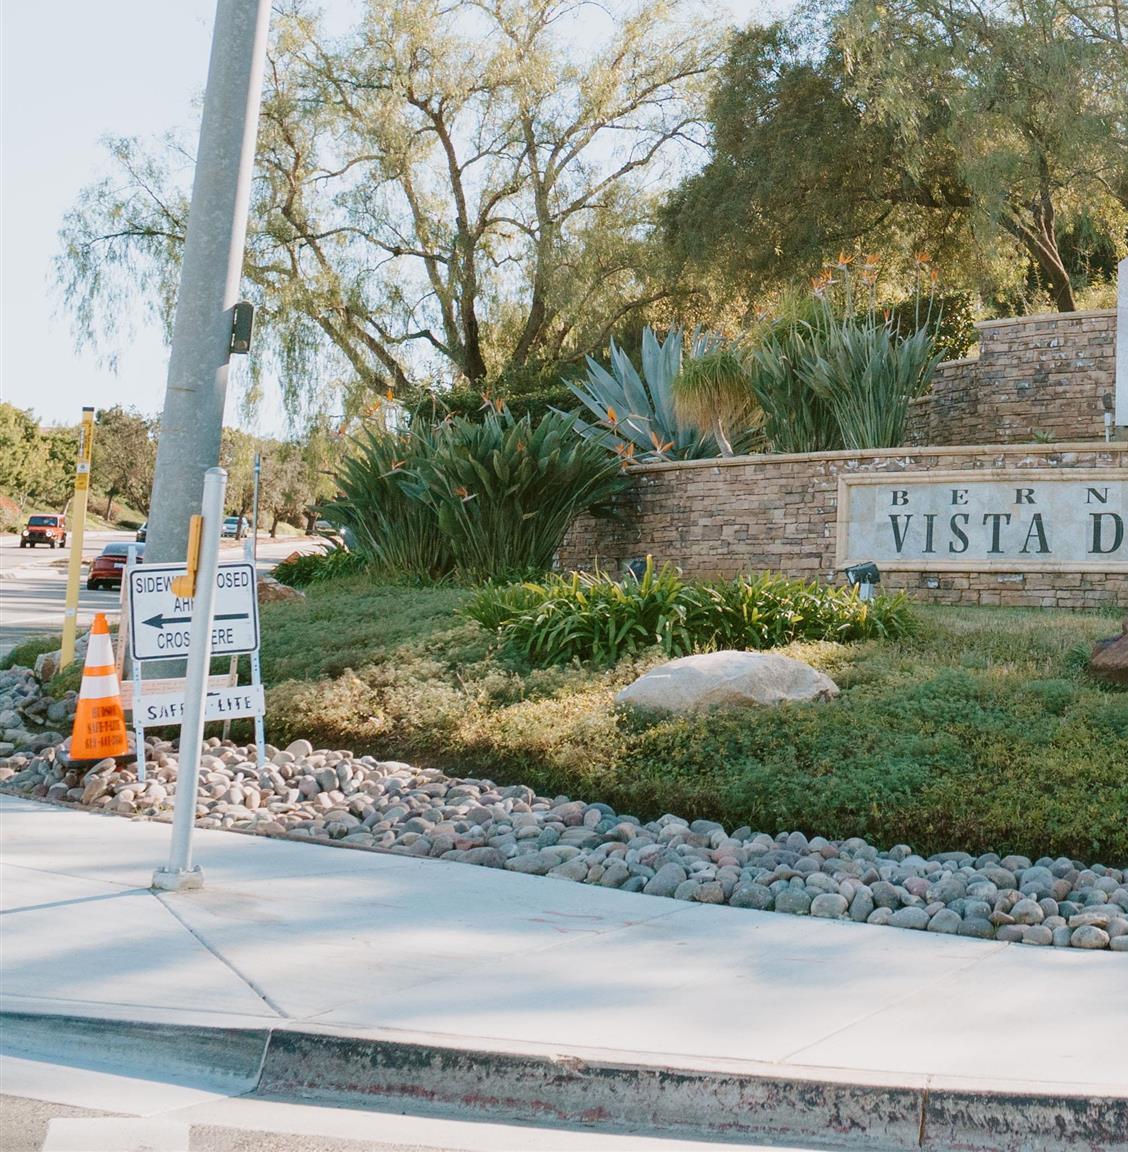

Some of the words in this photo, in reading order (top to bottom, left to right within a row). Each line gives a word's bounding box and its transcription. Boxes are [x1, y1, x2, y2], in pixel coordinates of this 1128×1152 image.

[888, 512, 1052, 554] VISTA
[135, 575, 174, 594] SIDEW
[216, 571, 249, 589] OSED
[157, 631, 191, 649] CROS
[211, 628, 234, 646] ERE
